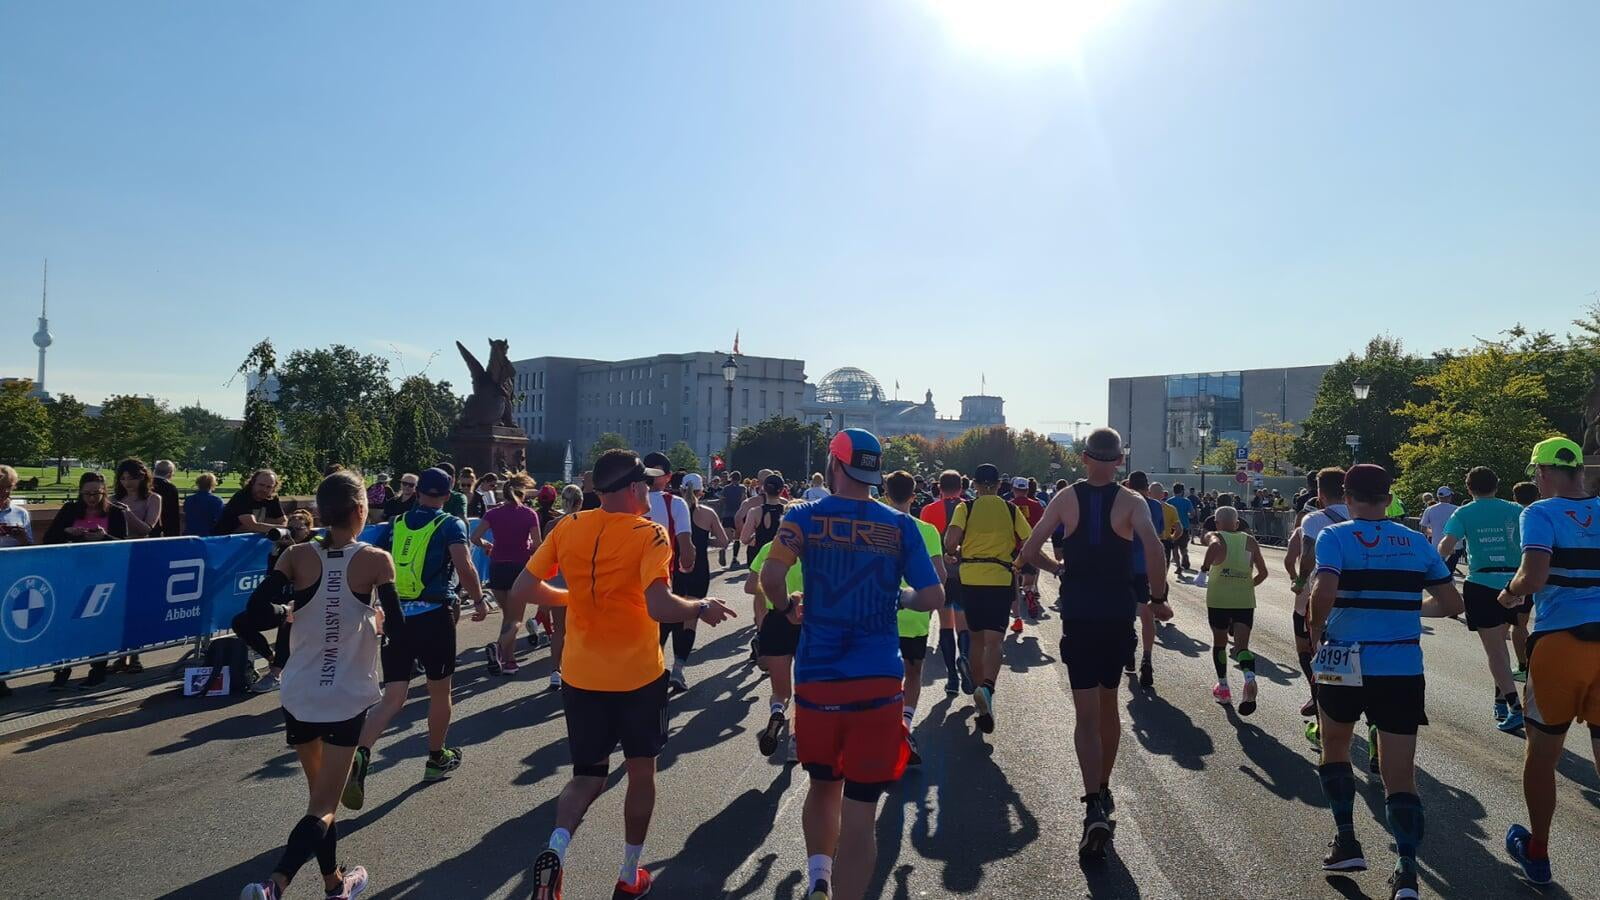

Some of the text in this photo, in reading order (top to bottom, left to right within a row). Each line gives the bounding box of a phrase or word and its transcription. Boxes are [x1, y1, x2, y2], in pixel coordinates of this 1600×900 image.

[1388, 536, 1411, 546] TUI
[10, 579, 49, 598] BMW
[326, 570, 342, 593] END
[165, 605, 201, 621] Abbott
[325, 597, 340, 643] PLASTIC
[320, 647, 338, 687] WASTE
